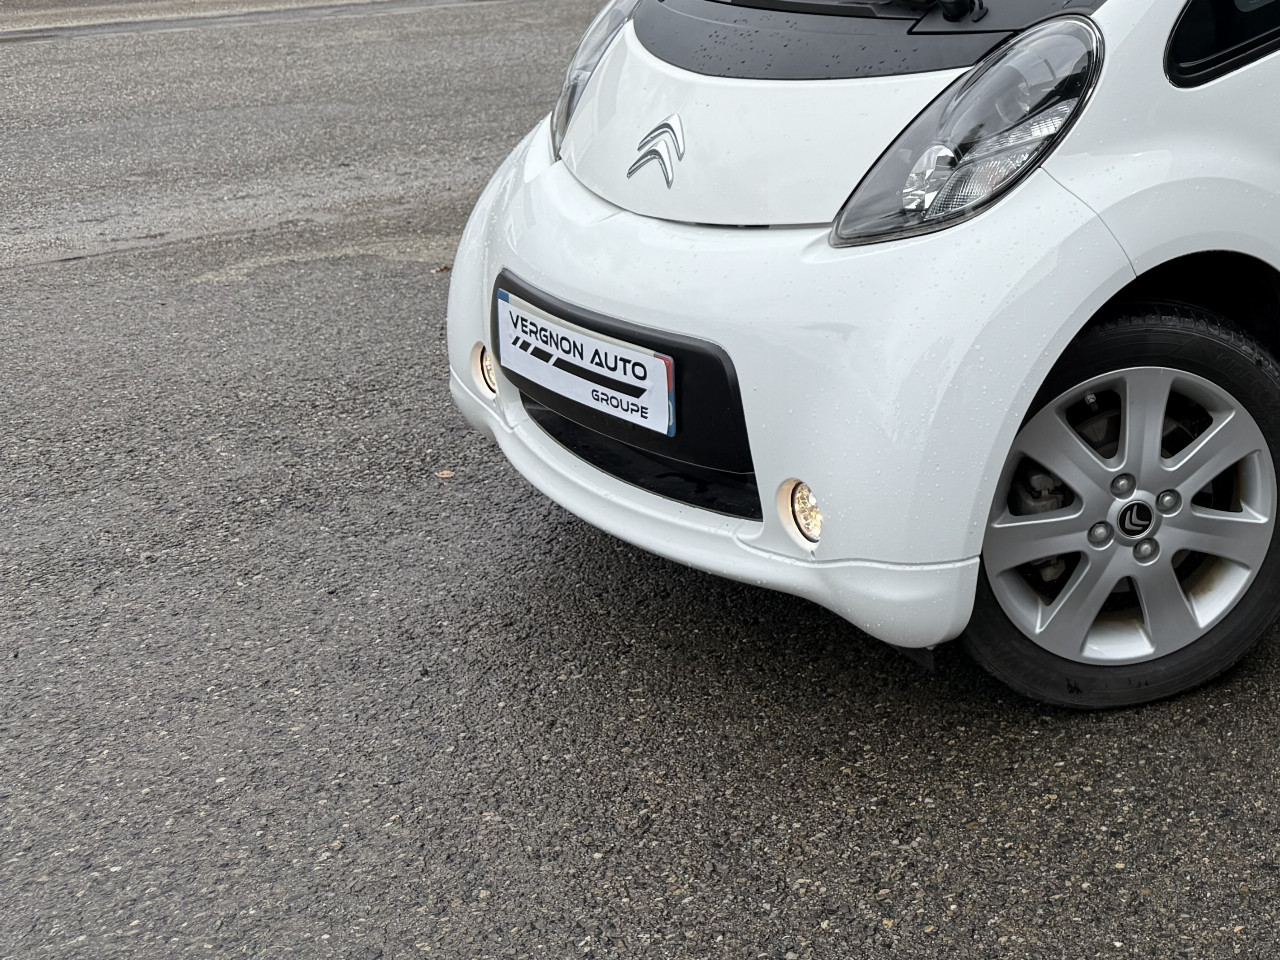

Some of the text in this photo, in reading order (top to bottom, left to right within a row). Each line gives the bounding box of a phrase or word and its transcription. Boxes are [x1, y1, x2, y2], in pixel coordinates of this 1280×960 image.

[508, 310, 648, 381] VERGNON AUTO
[591, 388, 649, 419] GROUPE
